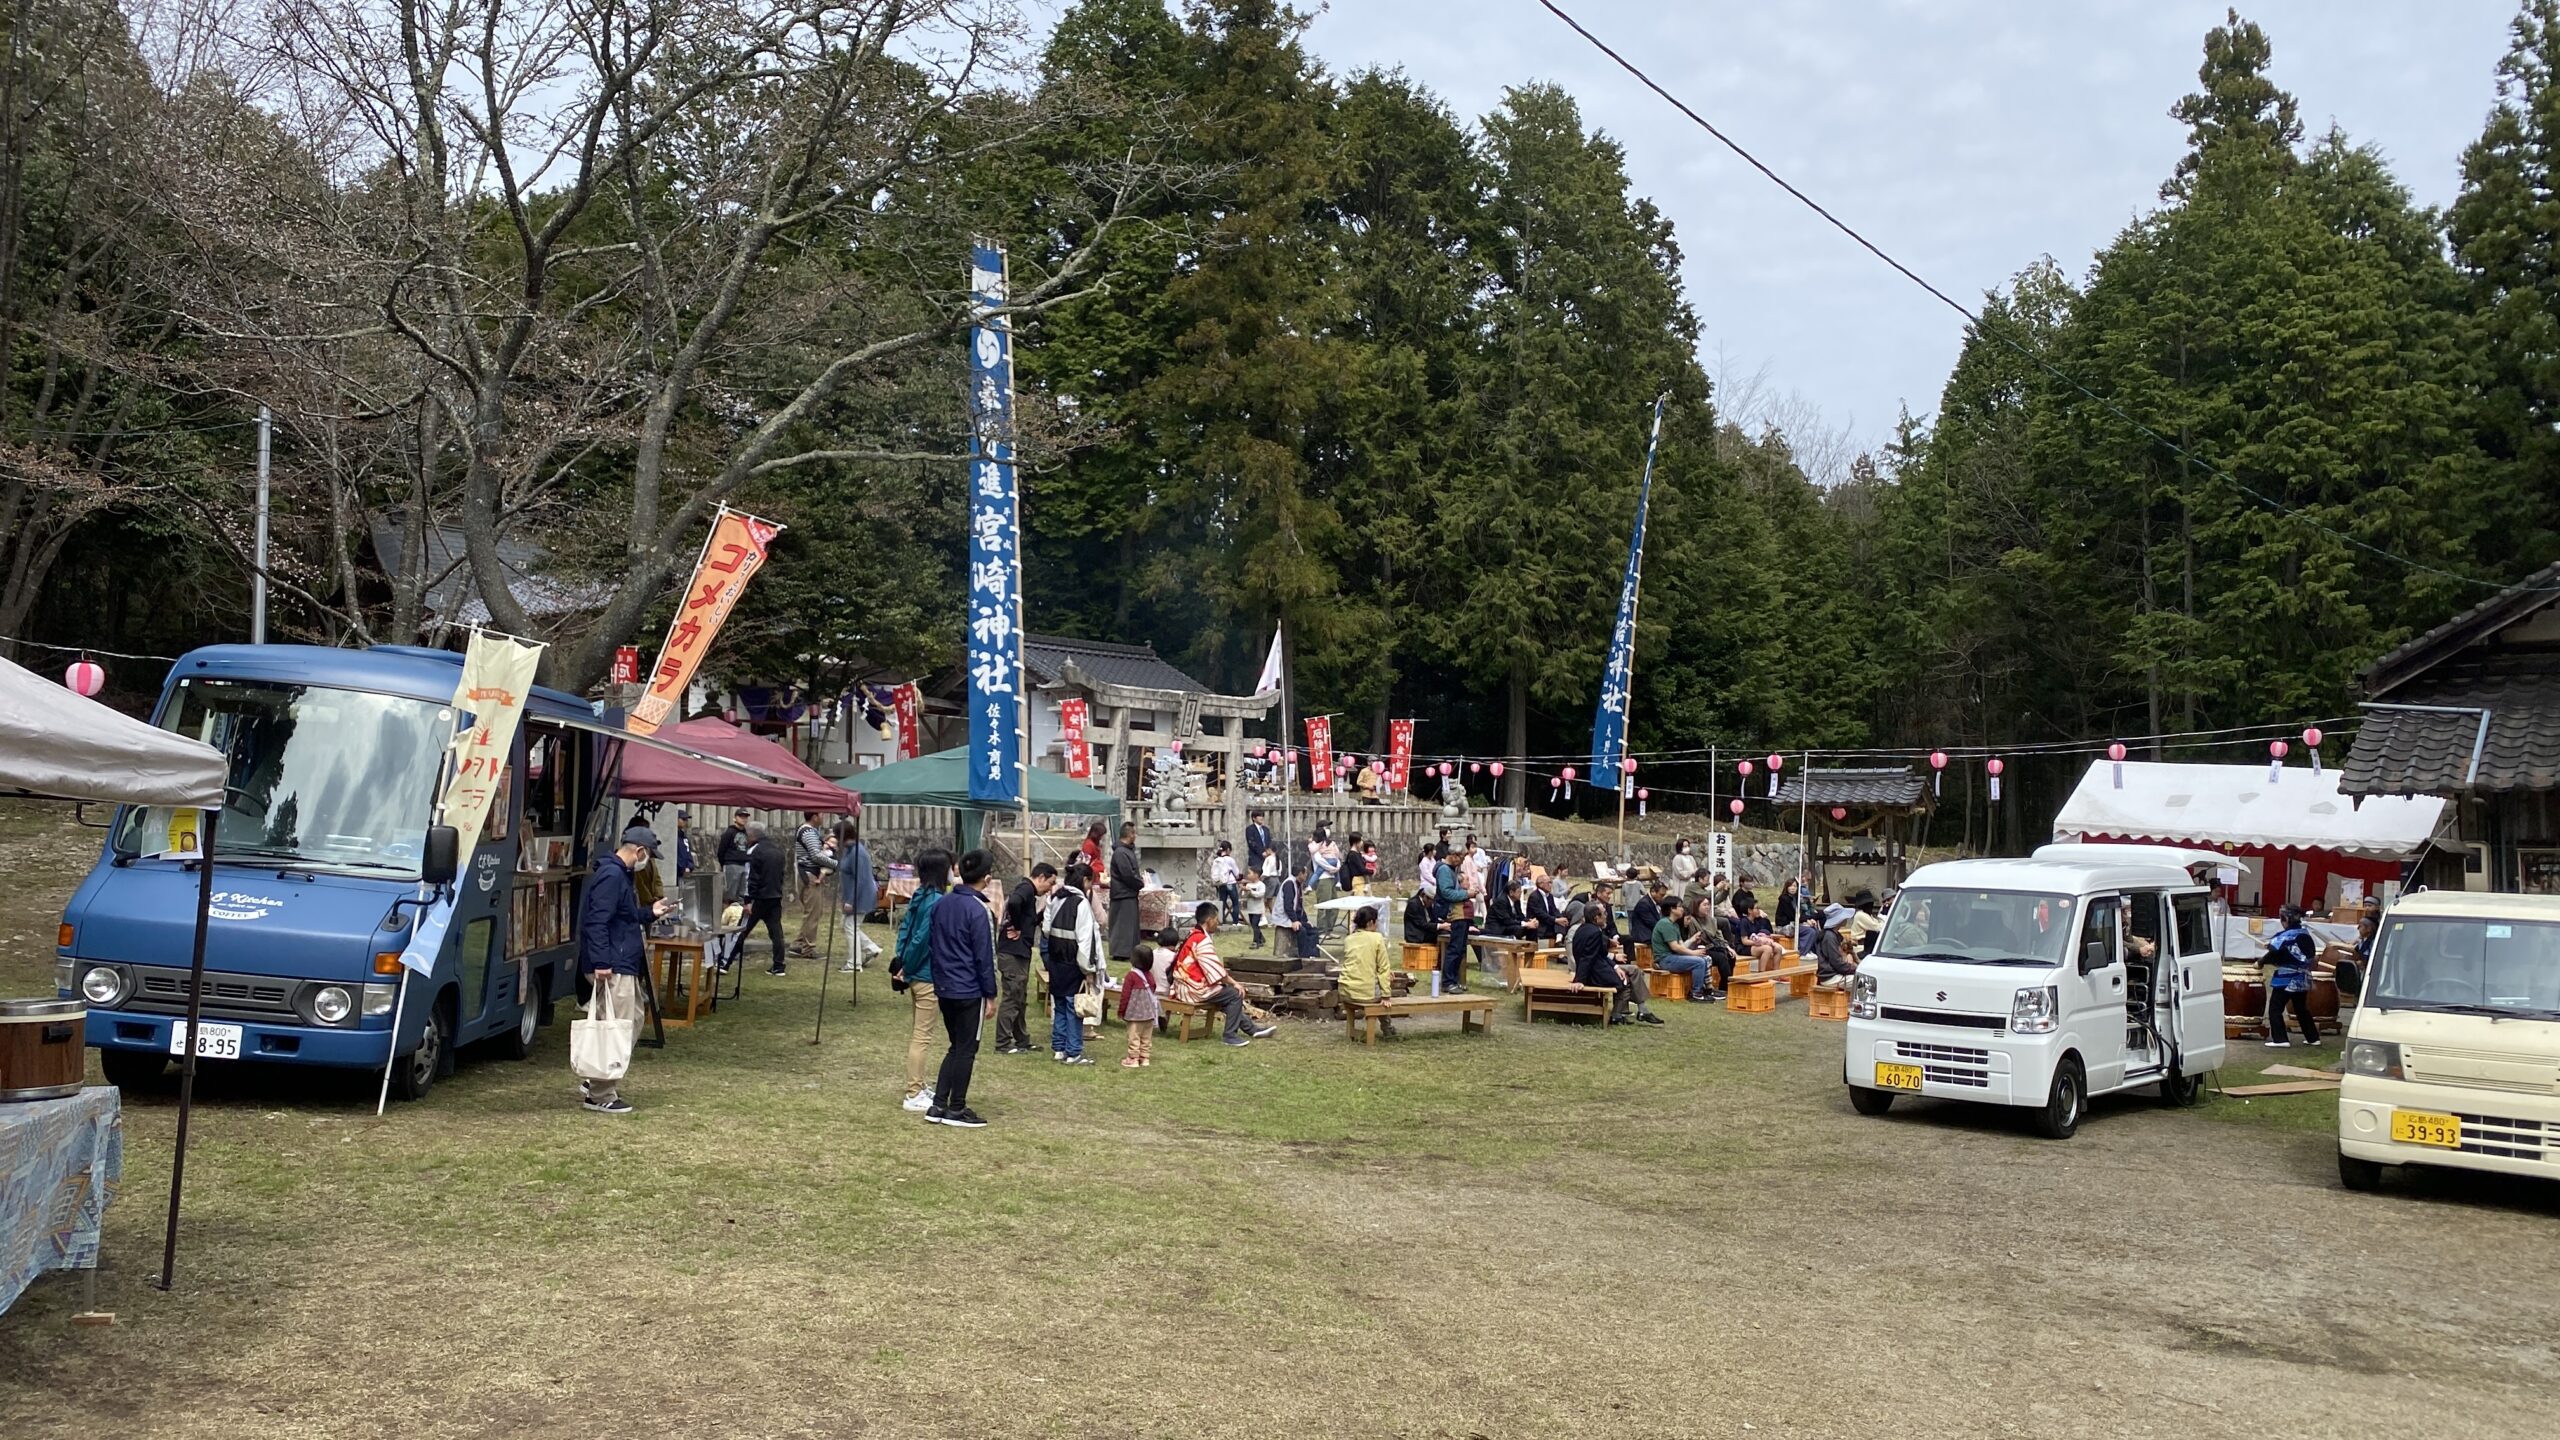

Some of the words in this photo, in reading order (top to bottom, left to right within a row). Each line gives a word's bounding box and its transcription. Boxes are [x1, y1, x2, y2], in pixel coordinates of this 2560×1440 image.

[970, 503, 980, 659] 十一月吉日
[1002, 506, 1015, 660] 平成十八年
[656, 543, 748, 693] コメカラ
[986, 703, 1001, 780] 佐々木育男
[1312, 729, 1326, 782] 厄除け祈願
[1394, 732, 1406, 783] 安全祈願
[231, 893, 284, 906] Kitchen
[1886, 1073, 1920, 1088] 60-70
[2407, 1124, 2456, 1143] 39-93
